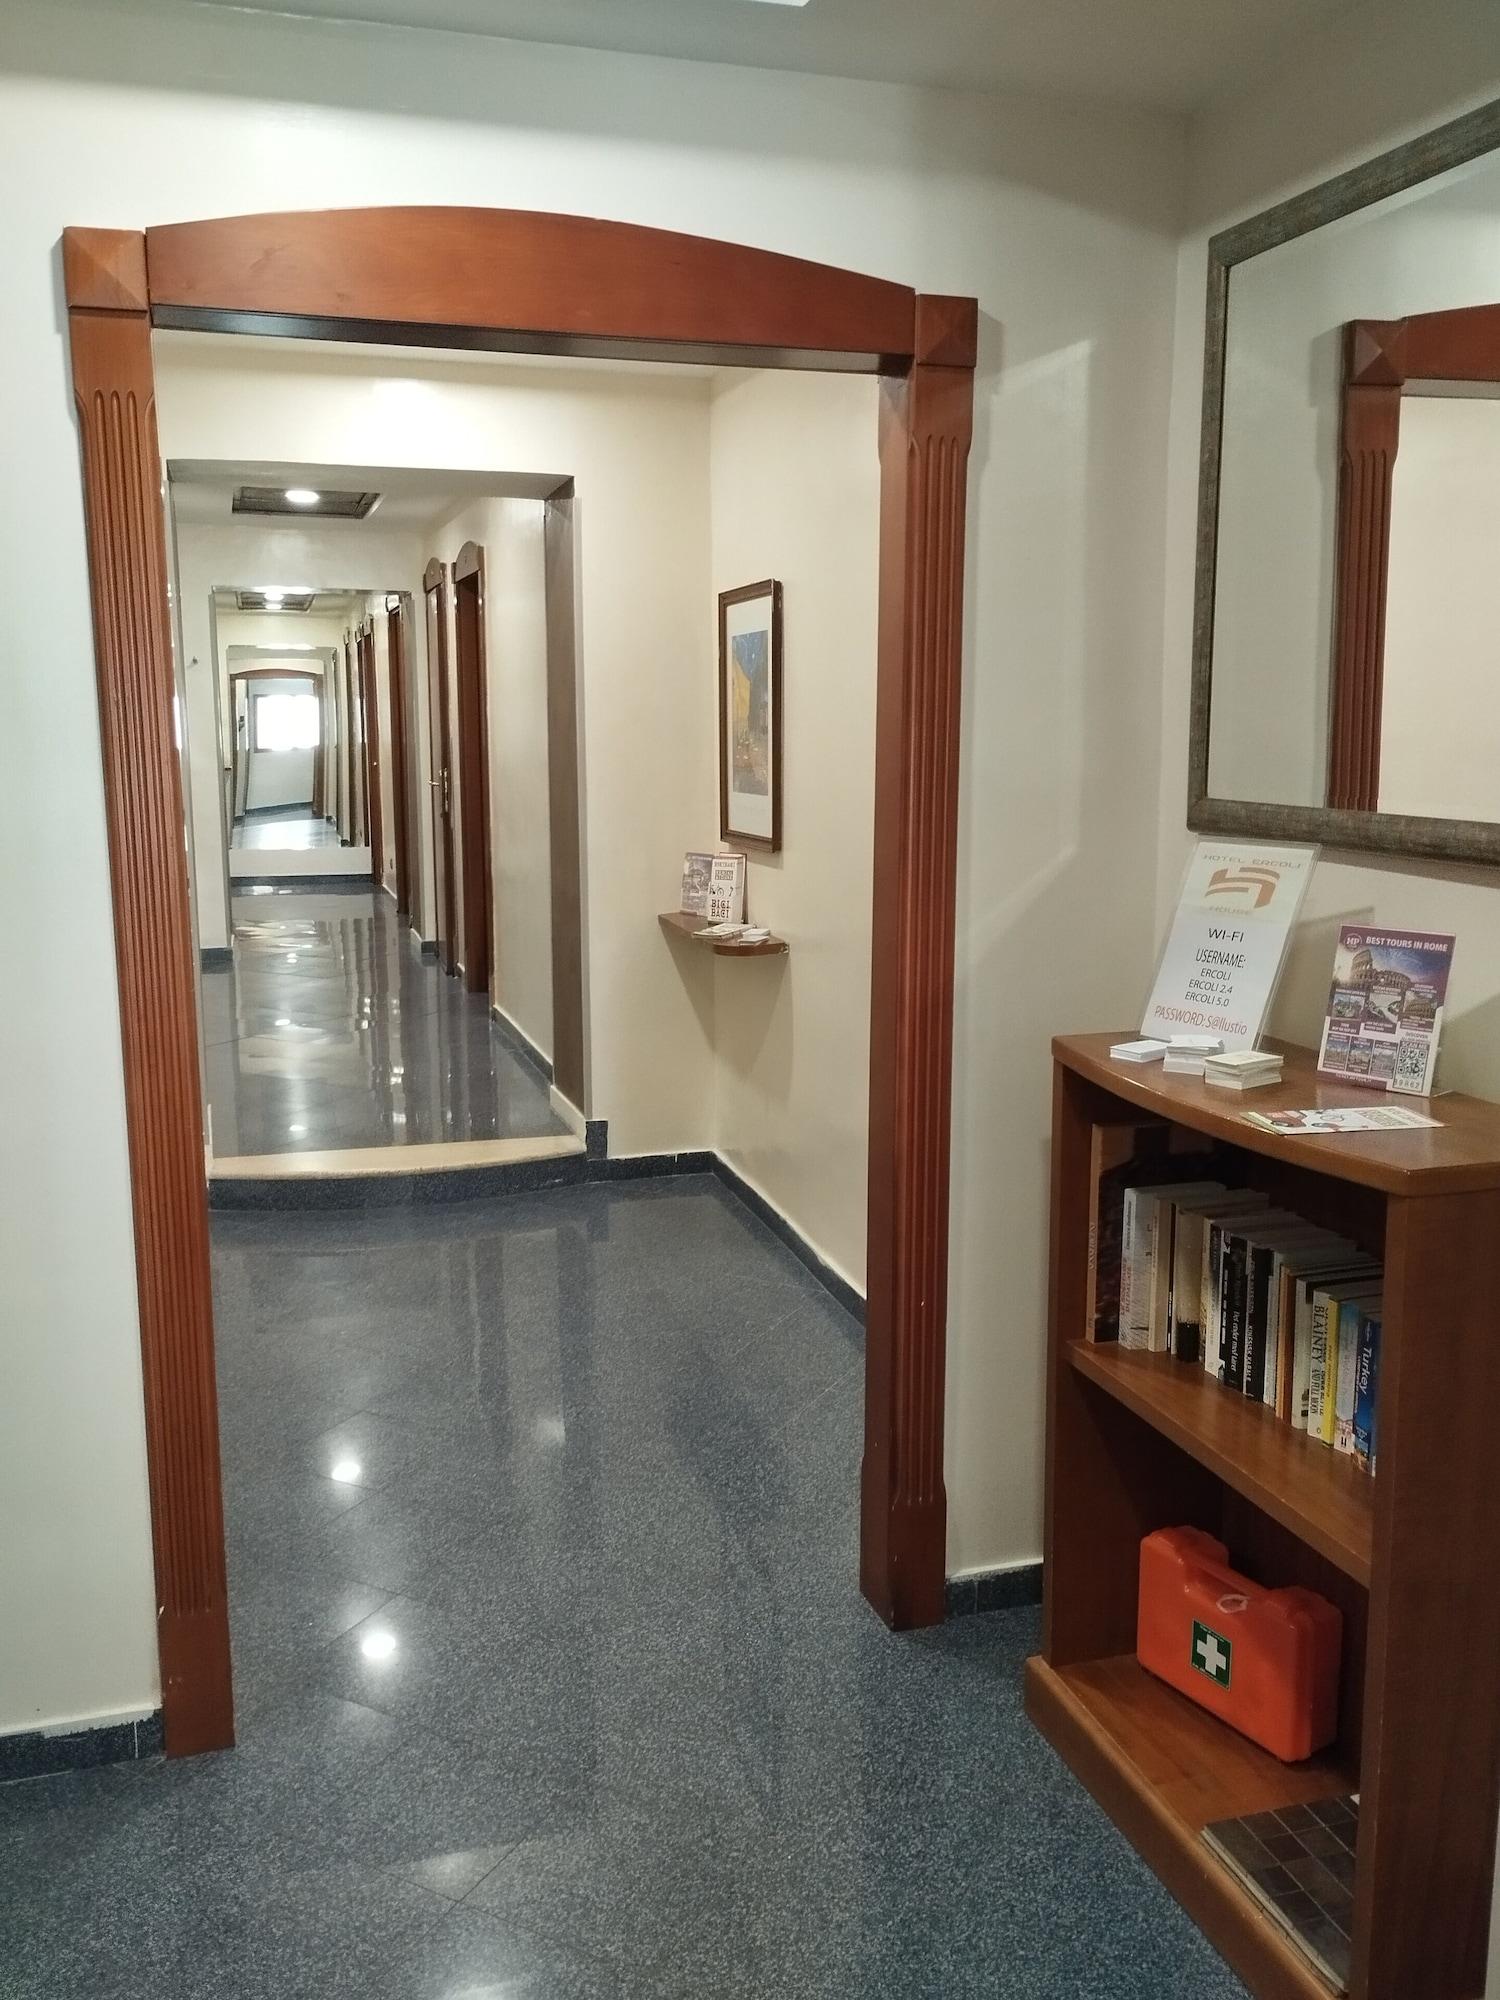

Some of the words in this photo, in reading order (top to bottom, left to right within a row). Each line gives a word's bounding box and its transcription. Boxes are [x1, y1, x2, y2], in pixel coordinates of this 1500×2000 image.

[1202, 854, 1245, 864] HOTEL
[1252, 859, 1303, 869] ERCOLI
[1208, 927, 1245, 942] WI-FI
[1366, 936, 1386, 946] BEST
[1386, 938, 1413, 949] TOURS
[1413, 942, 1422, 950] IN
[1423, 943, 1448, 952] ROME
[1196, 948, 1246, 969] USERNAME:
[1200, 968, 1232, 981] ERCOLI
[1188, 979, 1219, 992] ERCOLI
[1219, 984, 1233, 994] 2.4
[1185, 991, 1215, 1005] ERCOLI
[1216, 996, 1230, 1007] 5.0
[1311, 1305, 1325, 1364] BLAINEY
[1359, 1344, 1373, 1395] Turkey
